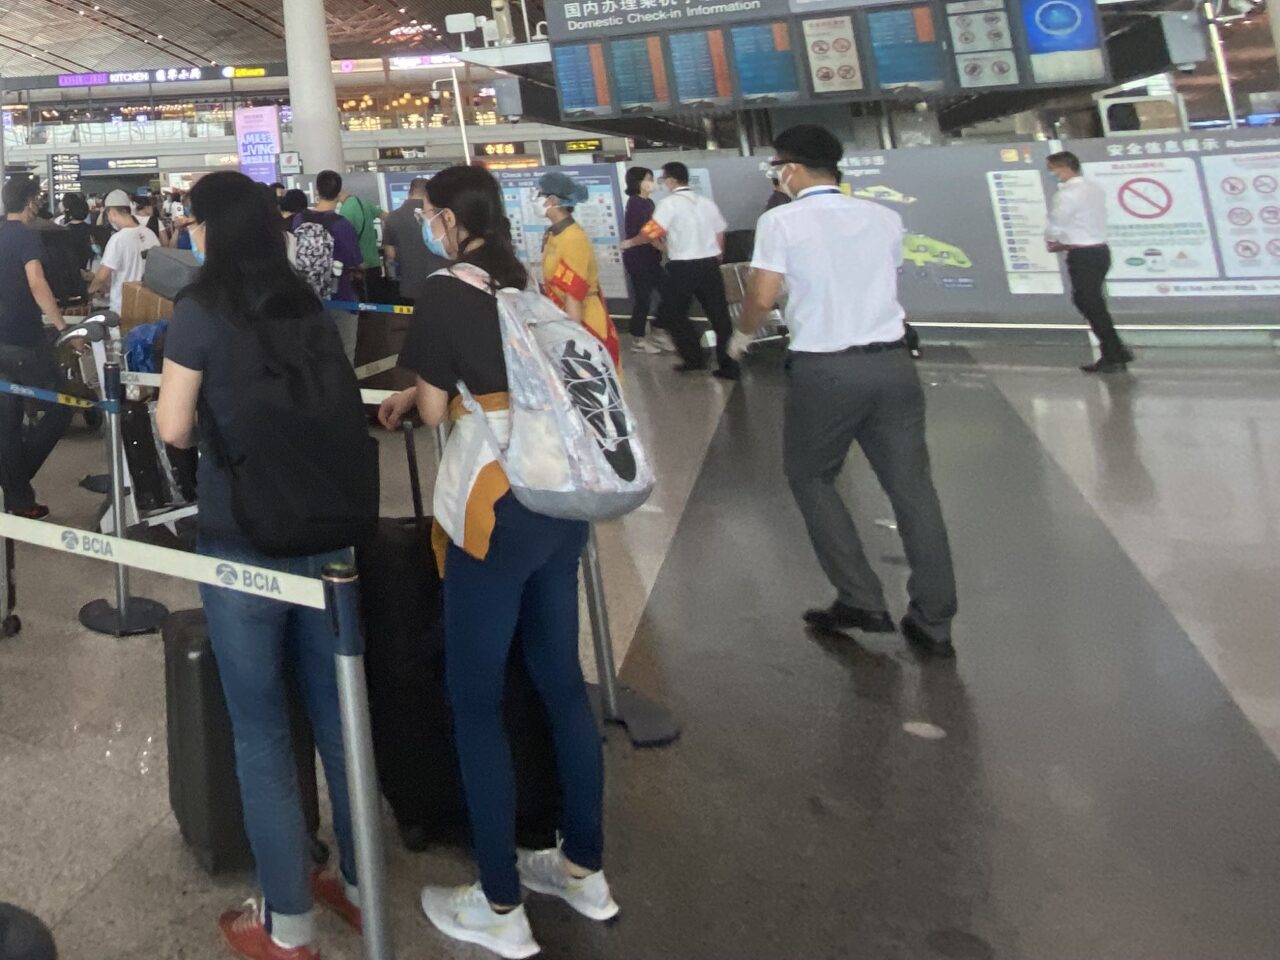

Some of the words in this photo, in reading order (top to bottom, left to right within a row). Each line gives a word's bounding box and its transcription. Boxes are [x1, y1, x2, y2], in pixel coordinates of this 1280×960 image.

[568, 17, 623, 31] Domestic
[627, 10, 681, 24] Check-in
[686, 0, 761, 17] Information
[109, 71, 149, 83] KITCHEN
[82, 535, 113, 557] BCIA
[242, 569, 282, 595] BCIA
